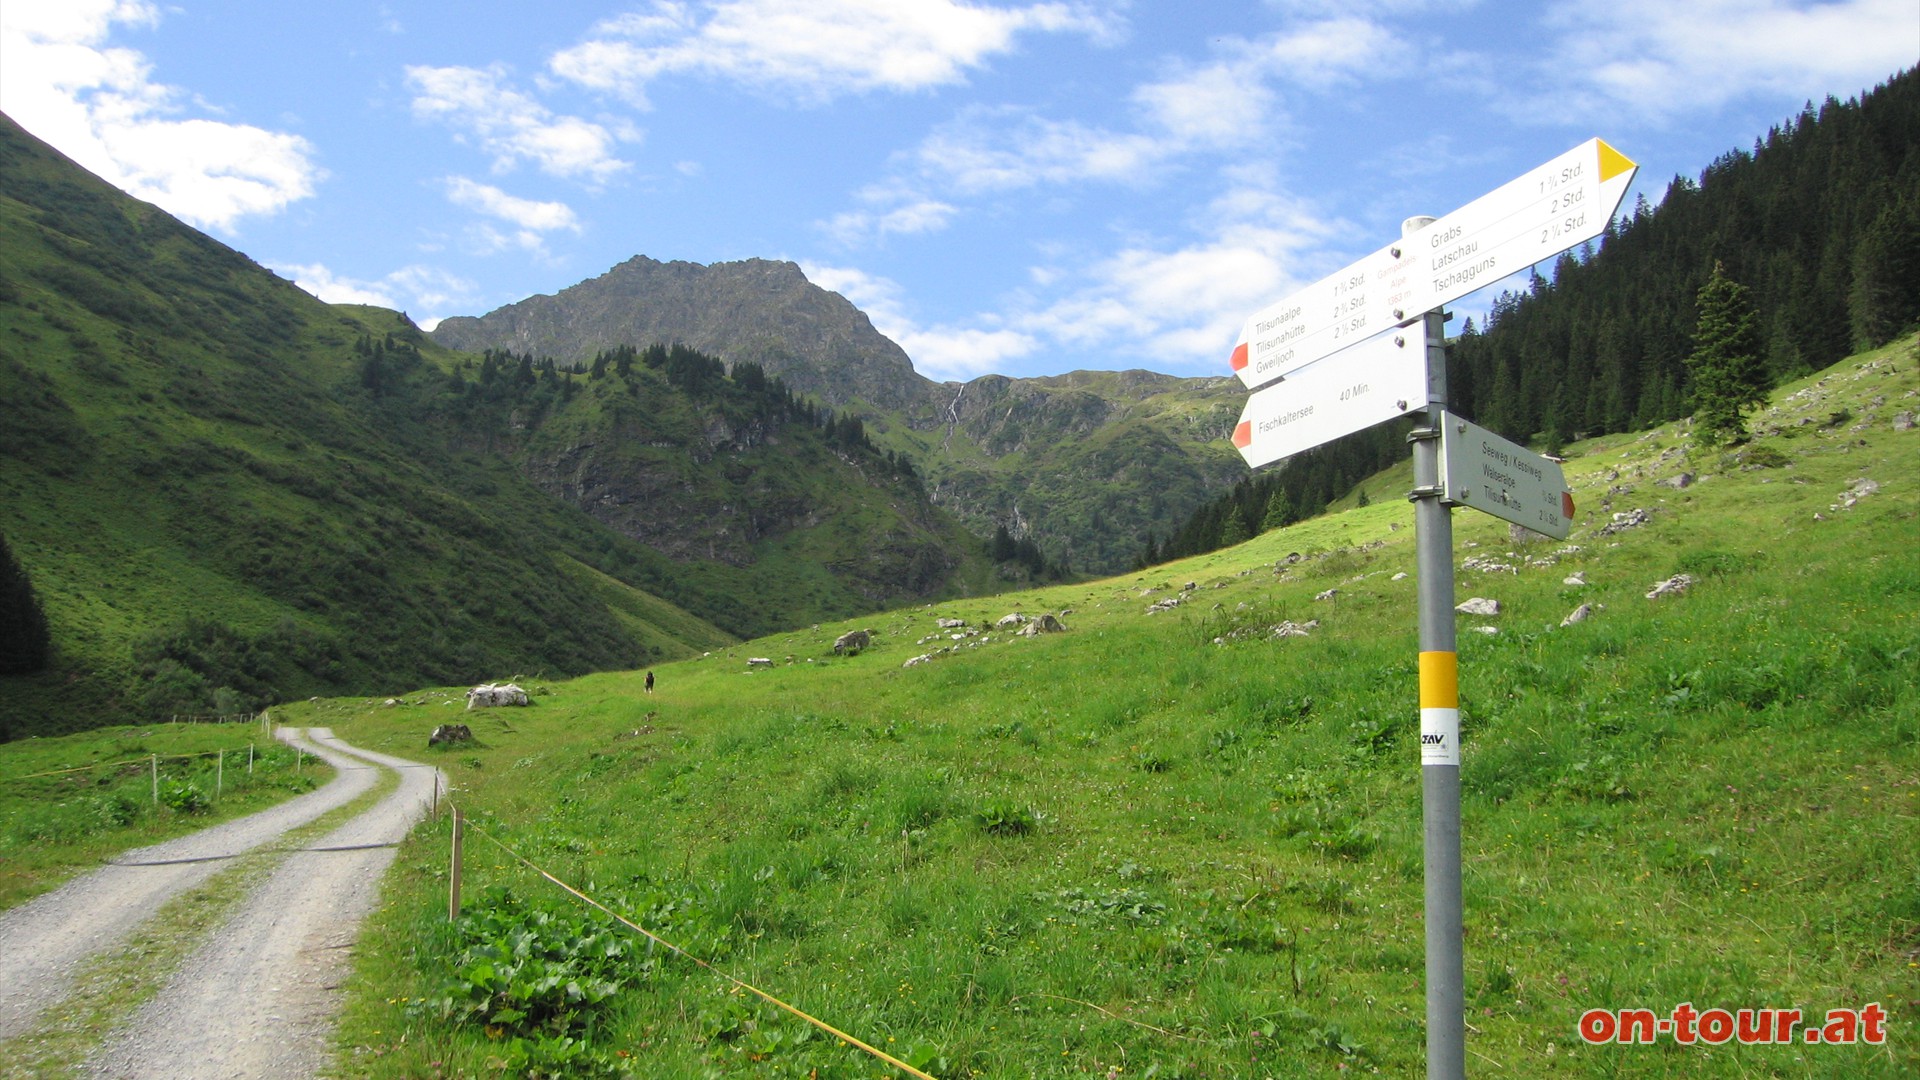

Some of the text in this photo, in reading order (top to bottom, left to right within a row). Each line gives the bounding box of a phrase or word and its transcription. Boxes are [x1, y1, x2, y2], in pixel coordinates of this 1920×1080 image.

[1431, 225, 1462, 248] Grabs
[1539, 181, 1544, 194] 1
[1561, 162, 1584, 184] Std.
[1432, 187, 1586, 271] Latschau 2 Std.
[1433, 256, 1496, 293] Tschagguns
[1541, 229, 1548, 244] 2
[1564, 212, 1588, 234] Std.
[1255, 305, 1302, 335] Tilisunaalpe
[1334, 286, 1338, 297] 1
[1349, 273, 1366, 290] Std.
[1390, 276, 1407, 290] Alpe
[1403, 290, 1412, 299] m
[1255, 323, 1306, 355] Tilisunahütte
[1333, 307, 1339, 319] 2
[1350, 295, 1367, 311] Std.
[1255, 348, 1294, 374] Gweiljoch
[1334, 327, 1339, 340] 2
[1350, 316, 1367, 332] Std.
[1258, 382, 1370, 434] Fischkaltersee 40 Min.
[1482, 441, 1508, 467] Seeweg
[1483, 463, 1516, 488] Walseralpe
[1539, 509, 1543, 520] 2
